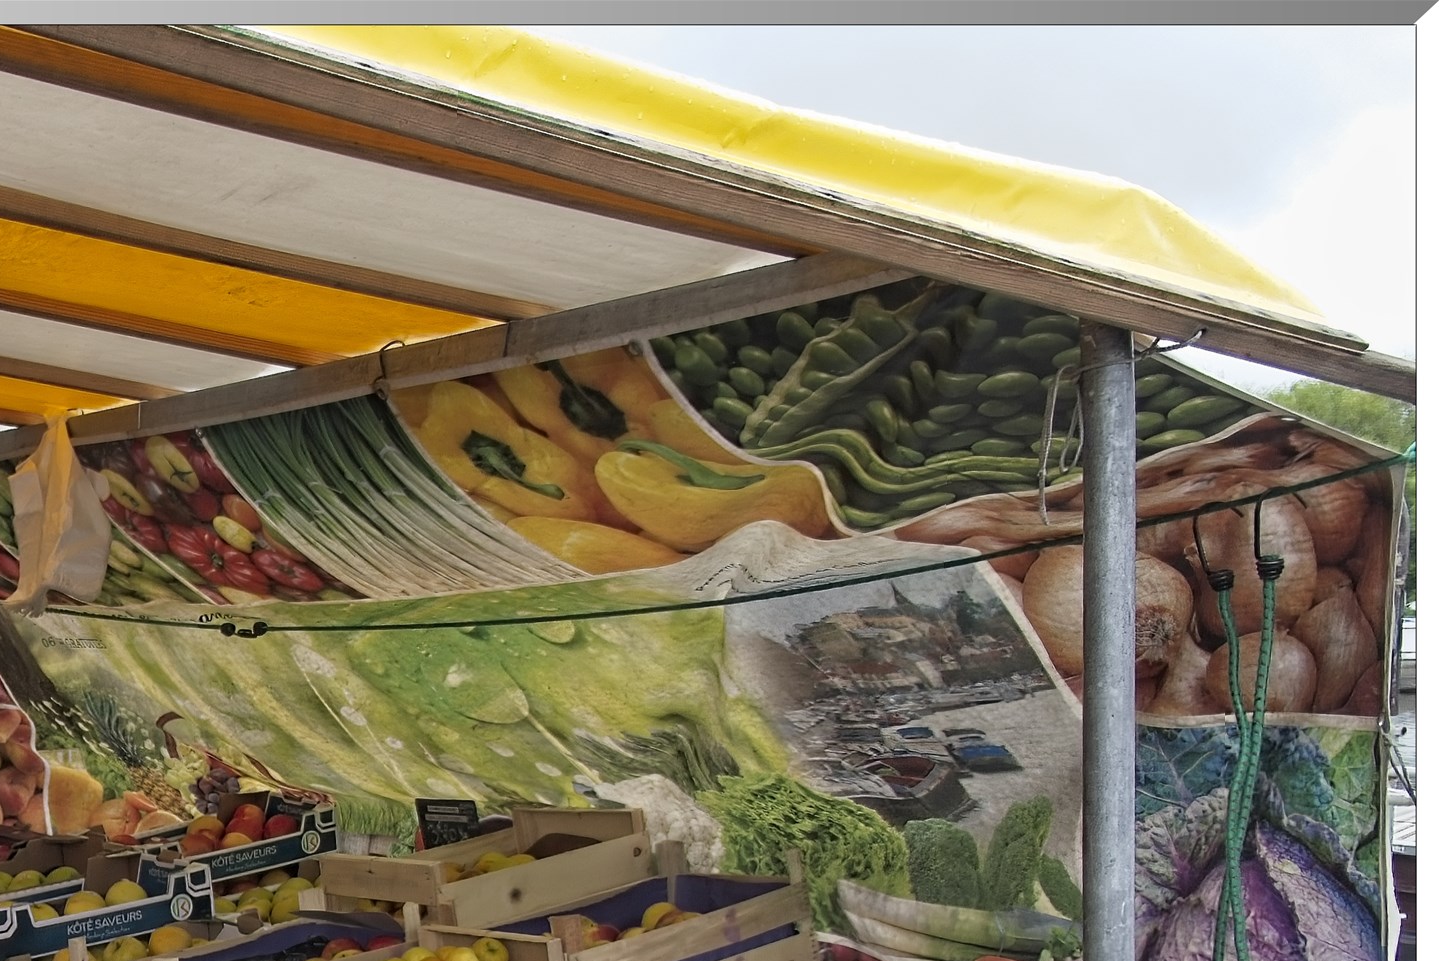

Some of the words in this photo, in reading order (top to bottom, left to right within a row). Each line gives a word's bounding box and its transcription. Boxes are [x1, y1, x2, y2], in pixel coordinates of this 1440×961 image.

[211, 856, 235, 868] KÔTÉ
[236, 845, 277, 863] SAVEURS
[67, 918, 94, 935] KÔTÉ
[95, 910, 142, 929] SAVEURS
